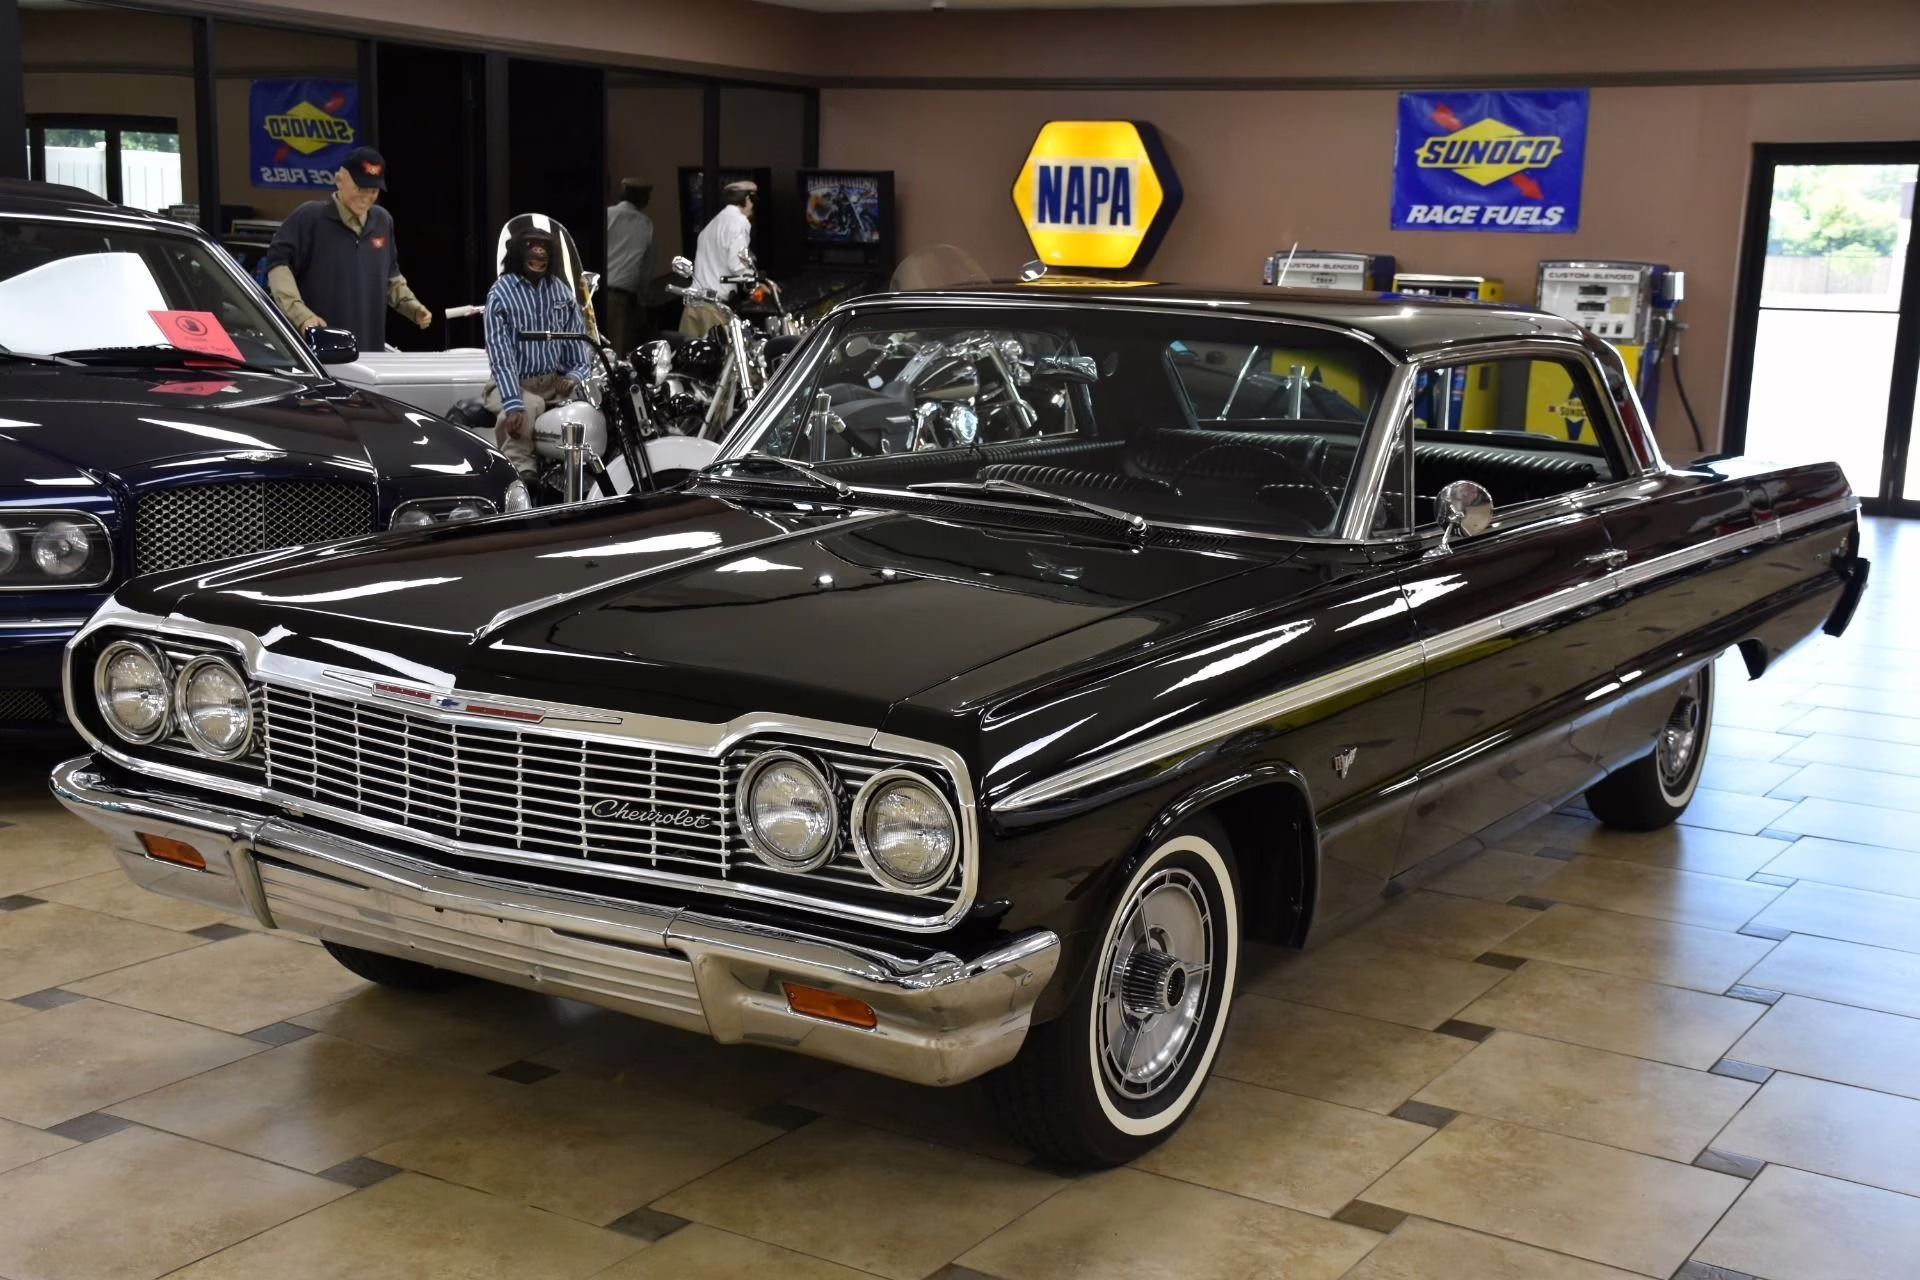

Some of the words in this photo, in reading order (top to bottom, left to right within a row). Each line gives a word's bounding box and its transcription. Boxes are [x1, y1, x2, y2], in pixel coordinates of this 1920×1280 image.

[1421, 139, 1556, 165] SUNOCO
[1038, 165, 1131, 226] NAPA
[1405, 204, 1481, 225] RACE
[1480, 205, 1566, 226] FUELS
[1559, 405, 1586, 417] SUNOC
[591, 799, 711, 829] Chevrolet
